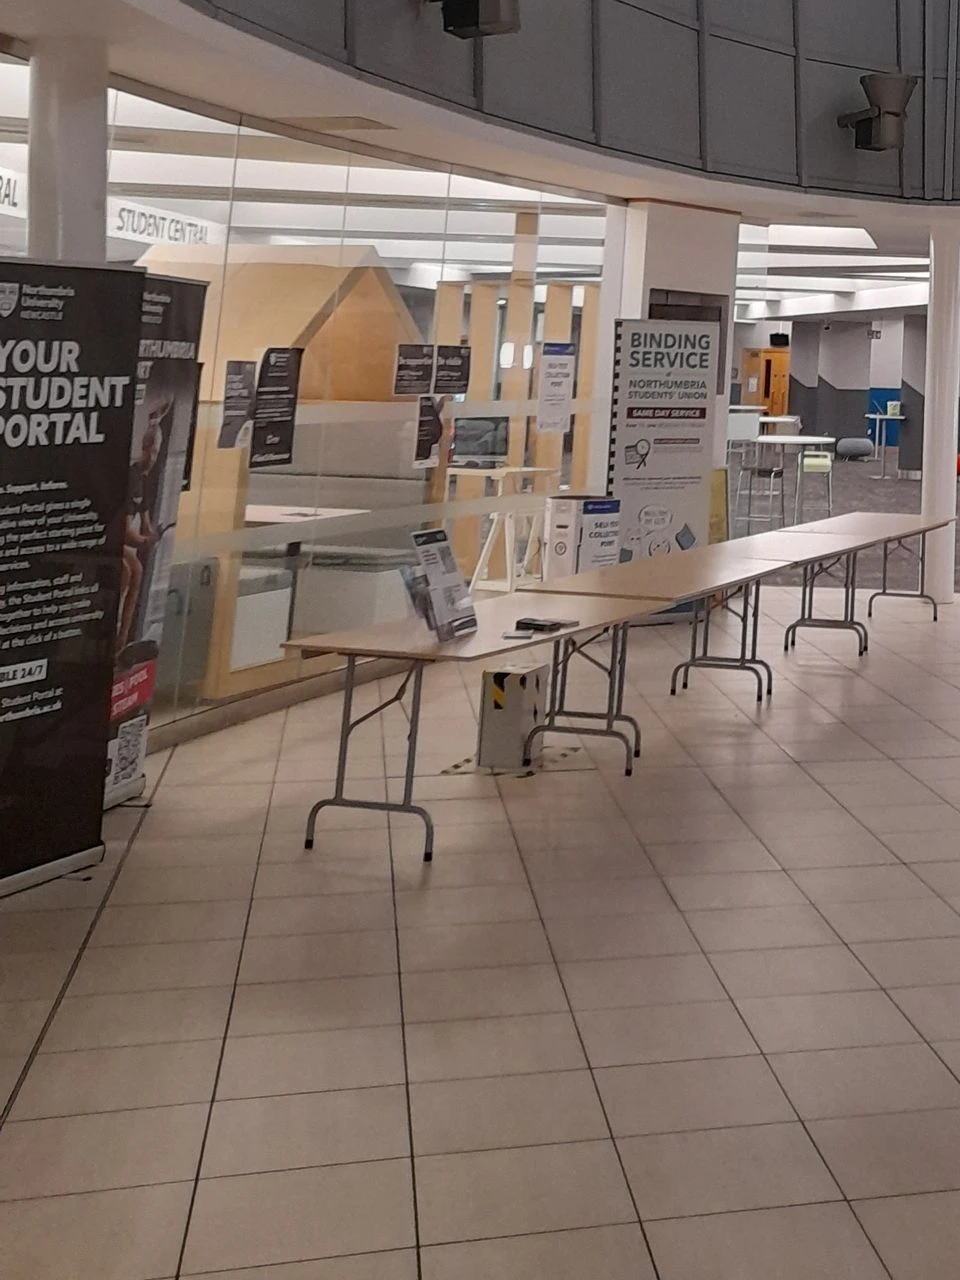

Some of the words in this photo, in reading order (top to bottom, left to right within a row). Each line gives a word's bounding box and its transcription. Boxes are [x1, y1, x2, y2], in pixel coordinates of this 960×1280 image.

[116, 207, 167, 238] STUDENT
[167, 218, 208, 244] CENTRAL
[630, 332, 711, 350] BINDING
[629, 350, 709, 369] SERVICE
[628, 379, 707, 389] NORTHUMBRIA
[678, 391, 707, 400] UNION
[632, 409, 654, 417] SAME
[654, 409, 670, 417] DAY
[670, 409, 700, 417] SERVICE
[20, 665, 43, 679] 24/7
